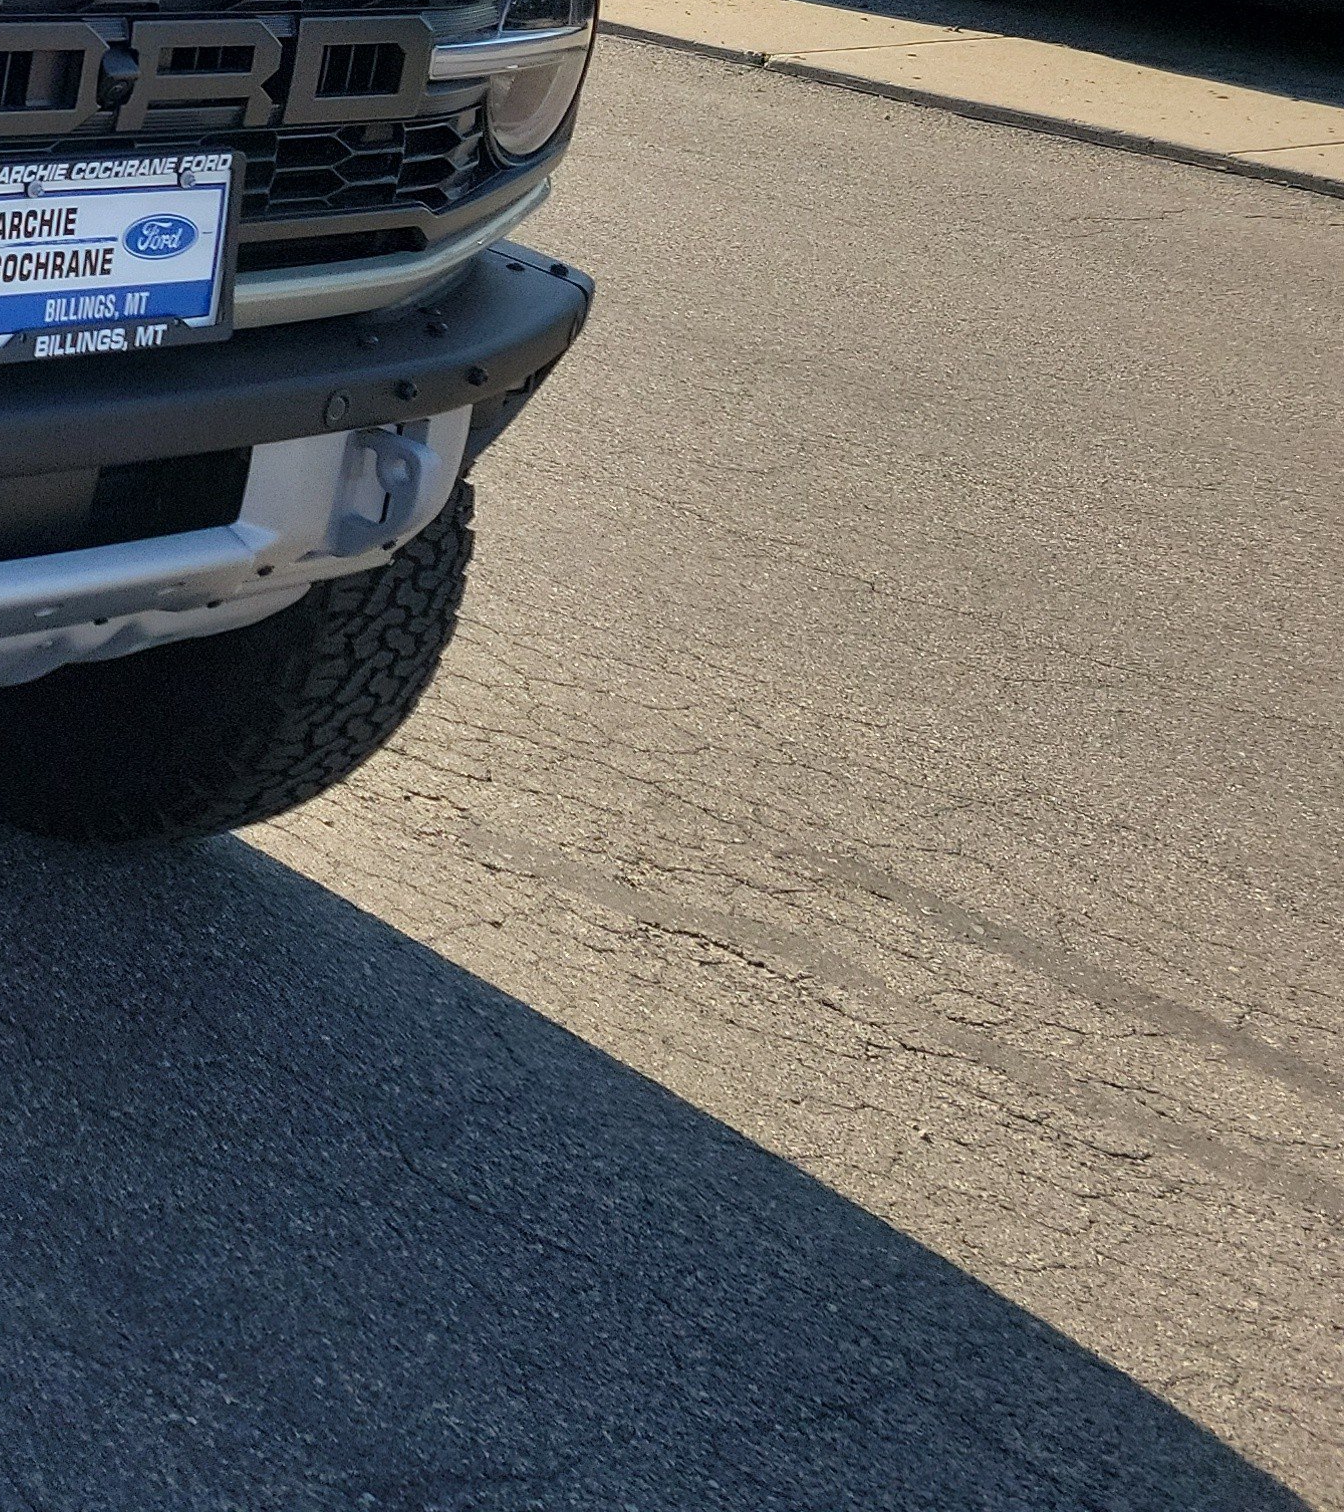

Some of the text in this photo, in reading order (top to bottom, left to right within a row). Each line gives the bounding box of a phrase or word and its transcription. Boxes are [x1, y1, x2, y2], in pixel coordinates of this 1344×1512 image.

[70, 156, 178, 182] COCHRANE
[179, 154, 233, 173] FORD
[137, 220, 182, 251] Ford
[44, 291, 150, 324] BILLINGS, MT
[34, 324, 168, 358] BILLINGS, MT
